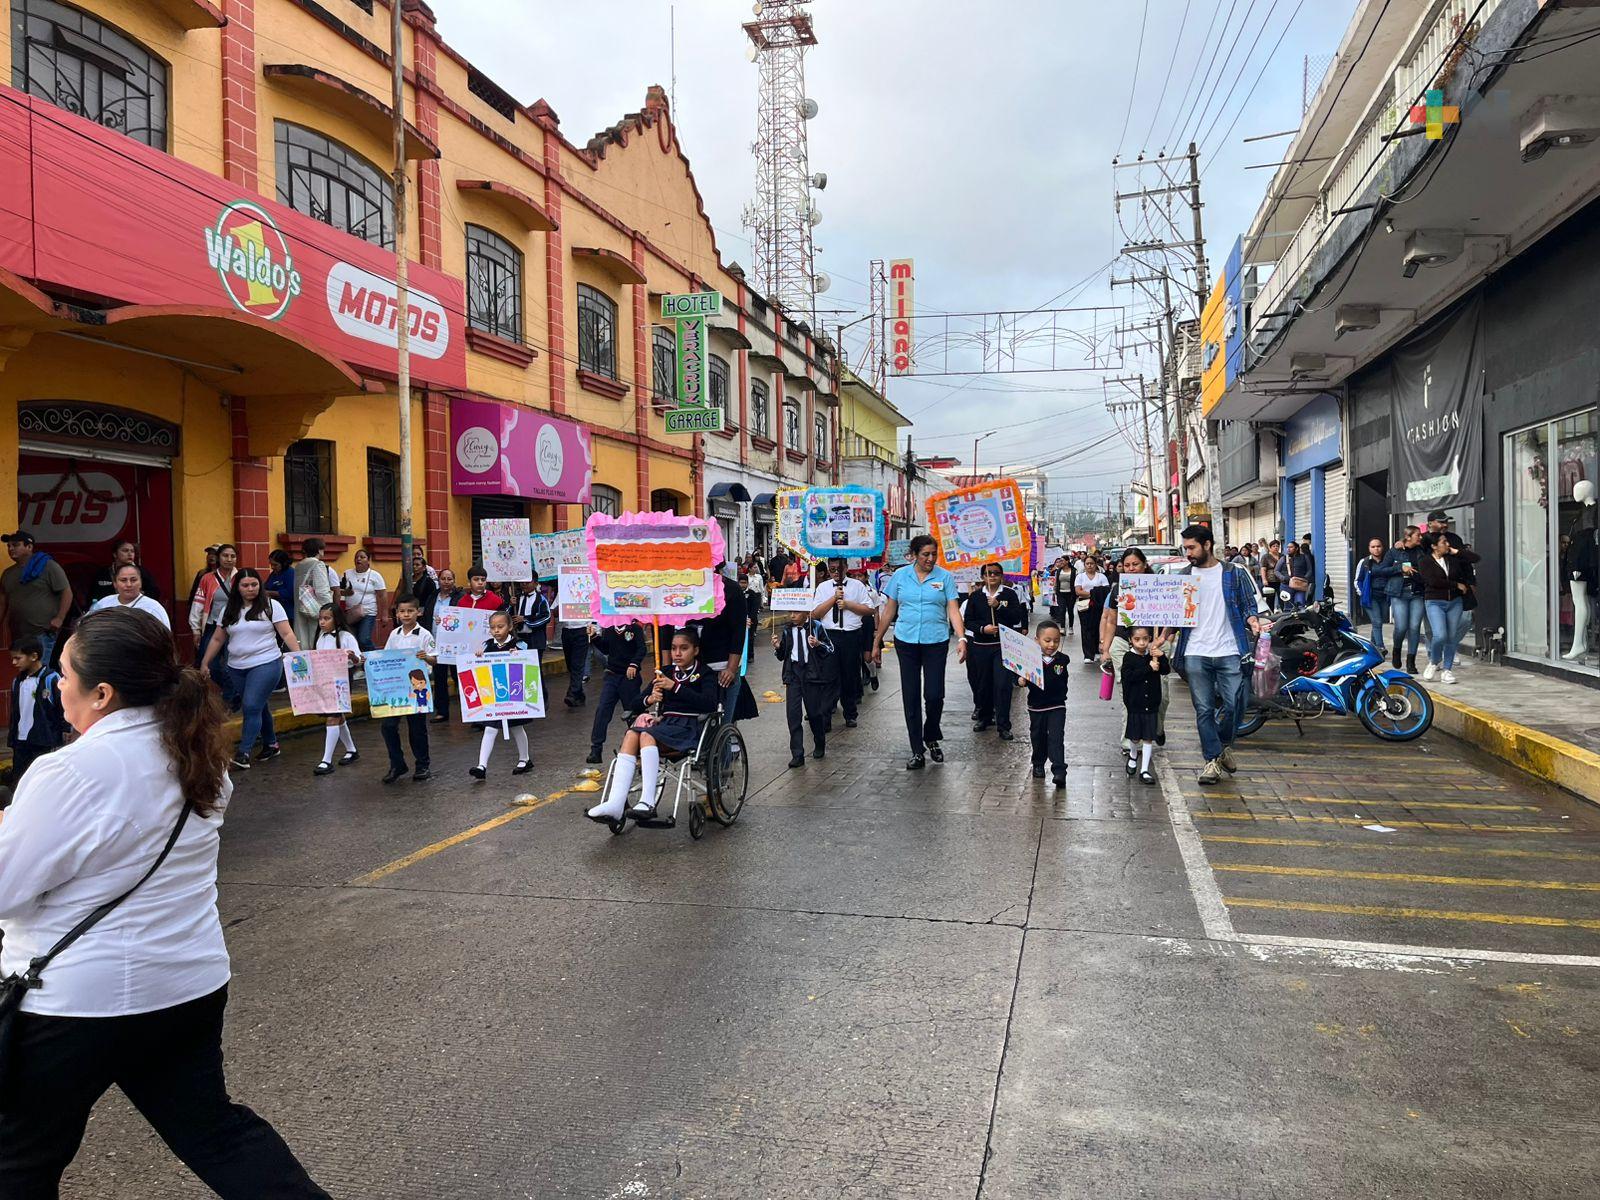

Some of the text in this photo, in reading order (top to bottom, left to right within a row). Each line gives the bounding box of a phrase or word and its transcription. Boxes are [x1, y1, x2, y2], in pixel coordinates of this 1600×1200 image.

[204, 227, 302, 296] Waldo's
[667, 296, 715, 312] HOTEL
[891, 264, 912, 370] milano
[682, 320, 701, 404] VERACRUZ
[668, 412, 717, 429] GARAGE
